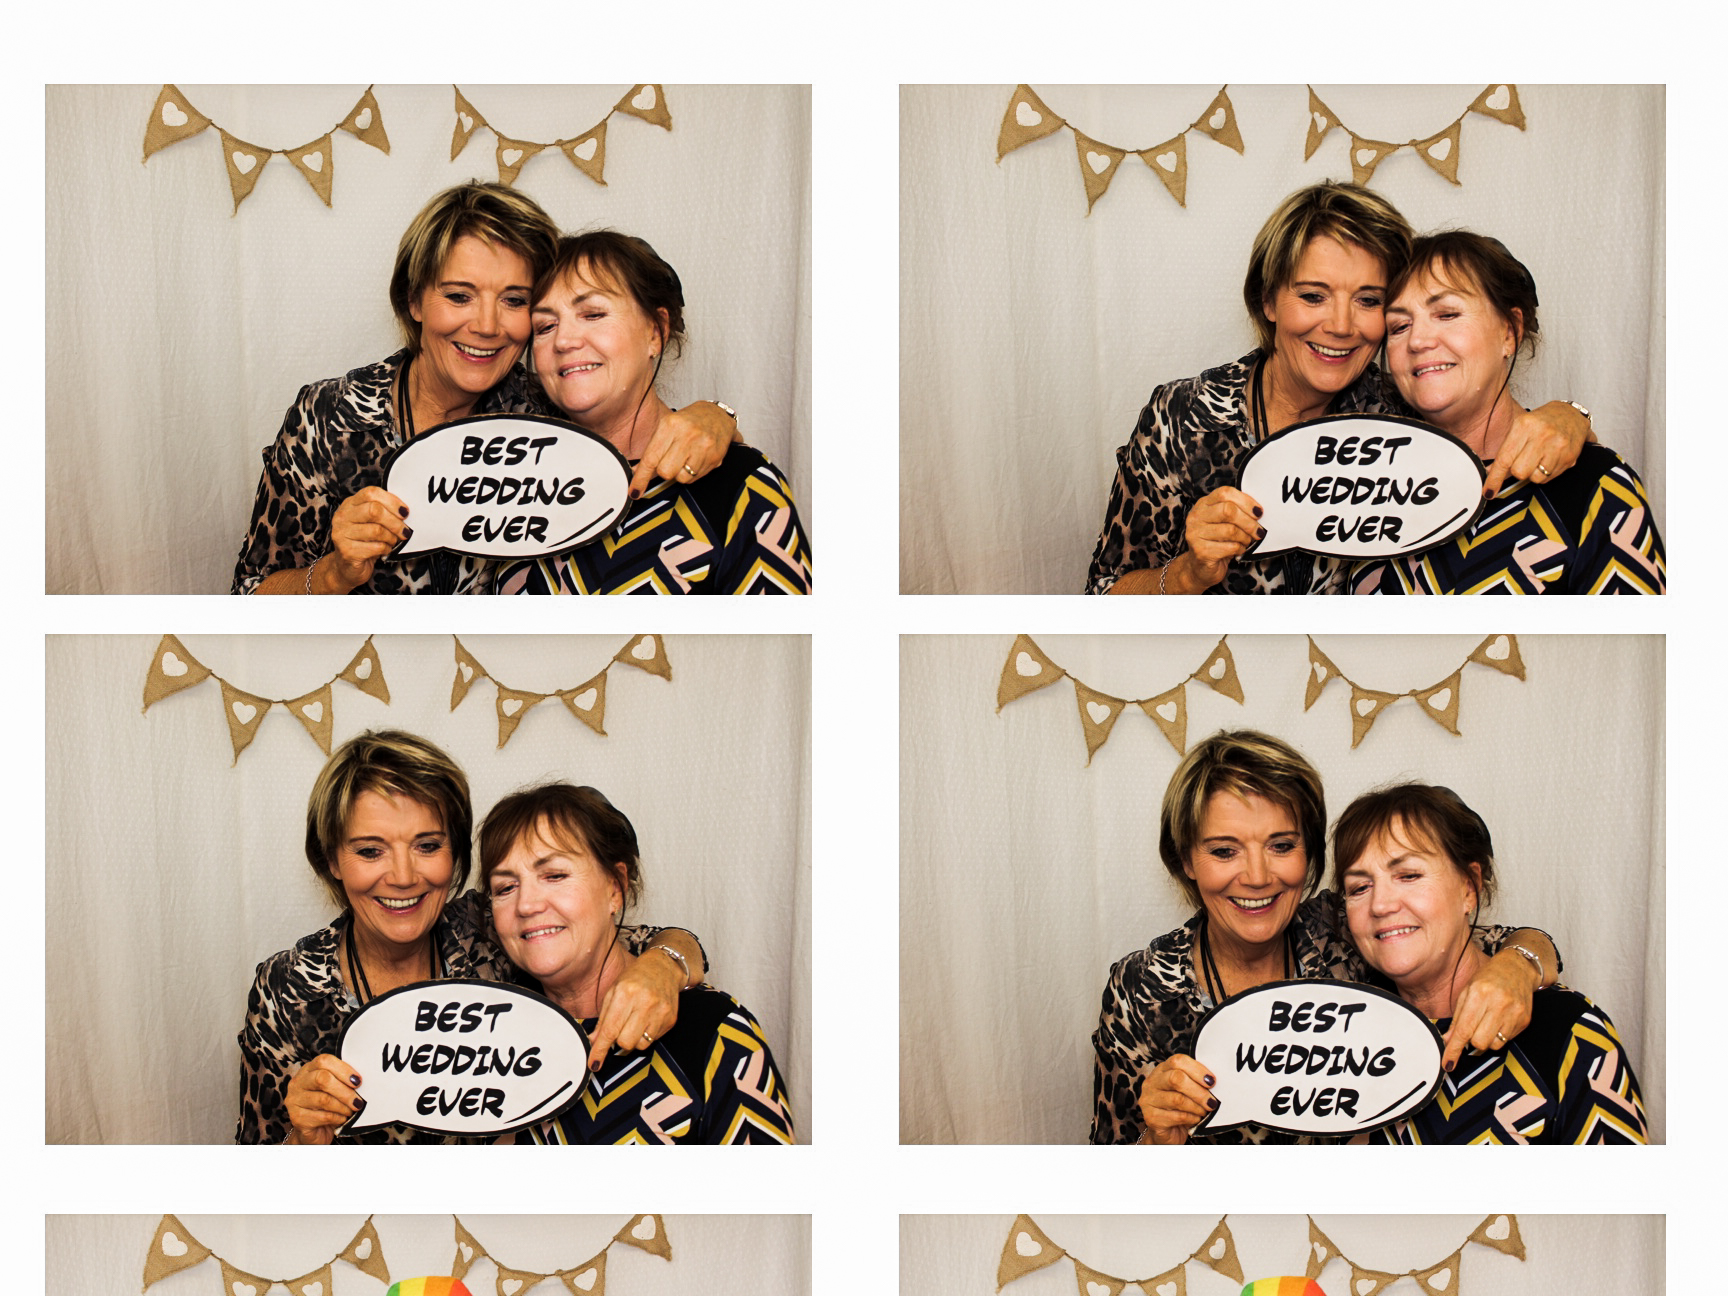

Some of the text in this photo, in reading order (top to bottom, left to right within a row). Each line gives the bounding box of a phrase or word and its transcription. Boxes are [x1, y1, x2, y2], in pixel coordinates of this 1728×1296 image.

[461, 436, 558, 465] BEST
[1315, 436, 1412, 465] BEST
[428, 476, 585, 505] WEDDING
[1282, 476, 1439, 505] WEDDING
[462, 515, 549, 543] EVER
[1316, 515, 1403, 543] EVER
[415, 1001, 512, 1032] BEST
[1269, 1001, 1366, 1032] BEST
[382, 1043, 542, 1076] WEDDING
[1237, 1043, 1396, 1076] WEDDING
[417, 1086, 505, 1118] EVER
[1271, 1086, 1359, 1118] EVER
